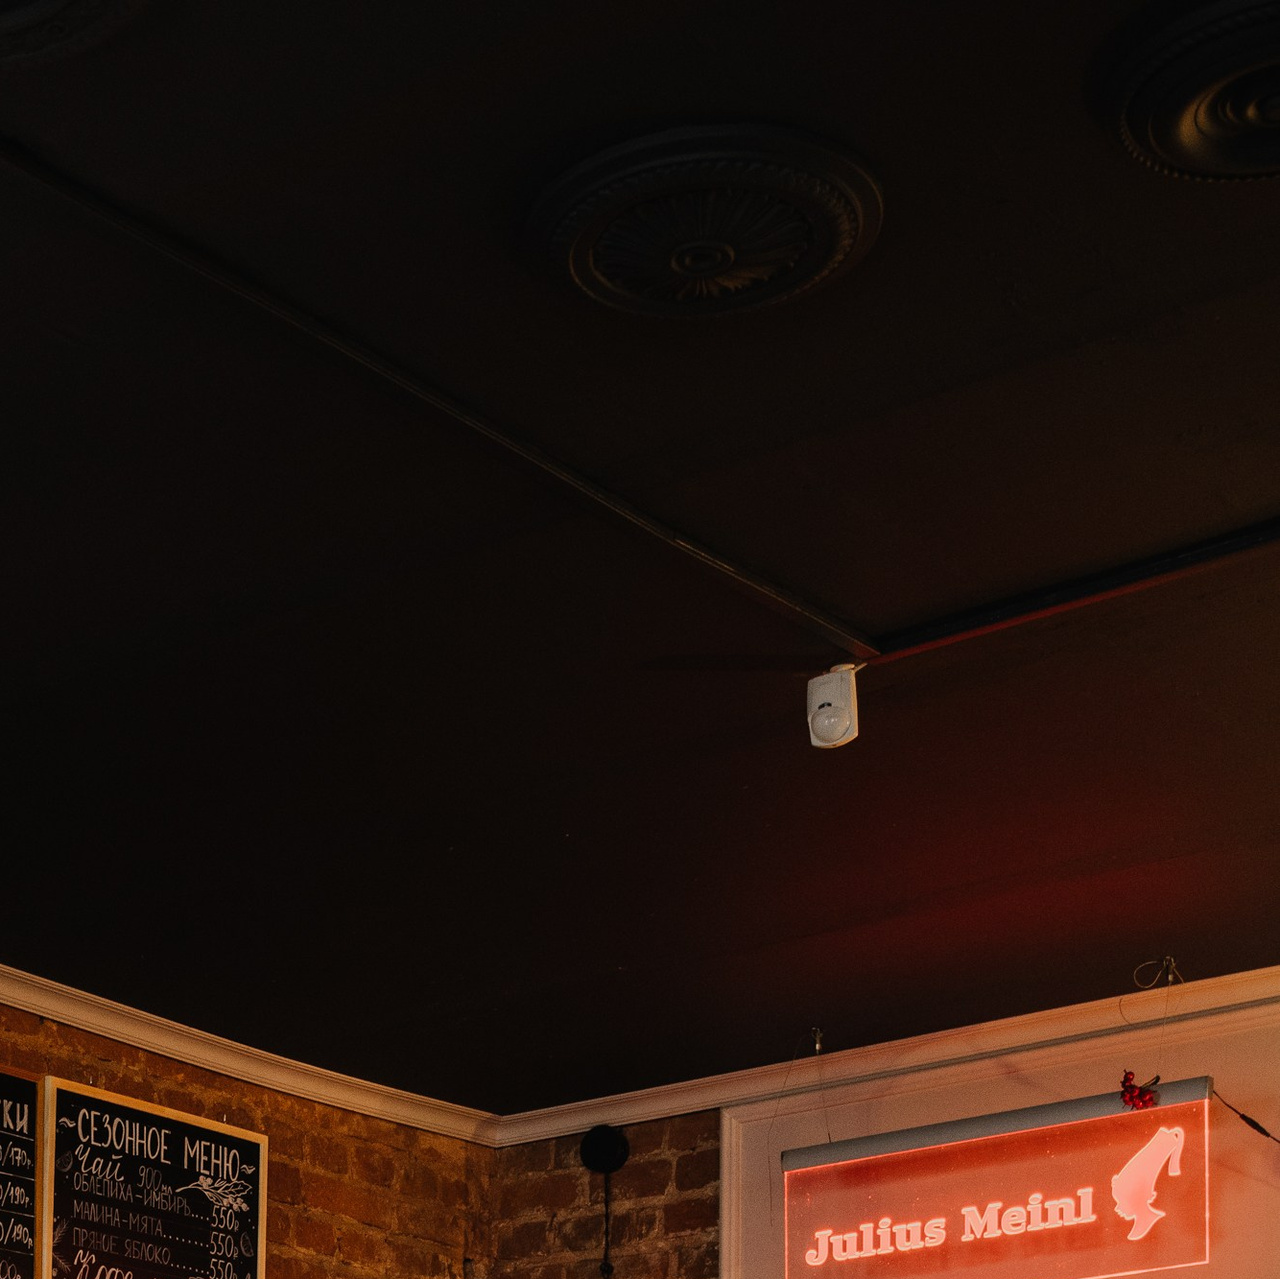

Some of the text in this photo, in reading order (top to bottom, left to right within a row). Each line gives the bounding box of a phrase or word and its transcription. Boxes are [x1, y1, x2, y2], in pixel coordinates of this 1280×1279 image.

[75, 1144, 124, 1182] Чай
[77, 1108, 239, 1181] СЕЗОННОЕ МЕНЮ
[805, 1187, 1097, 1266] Julius Meinl
